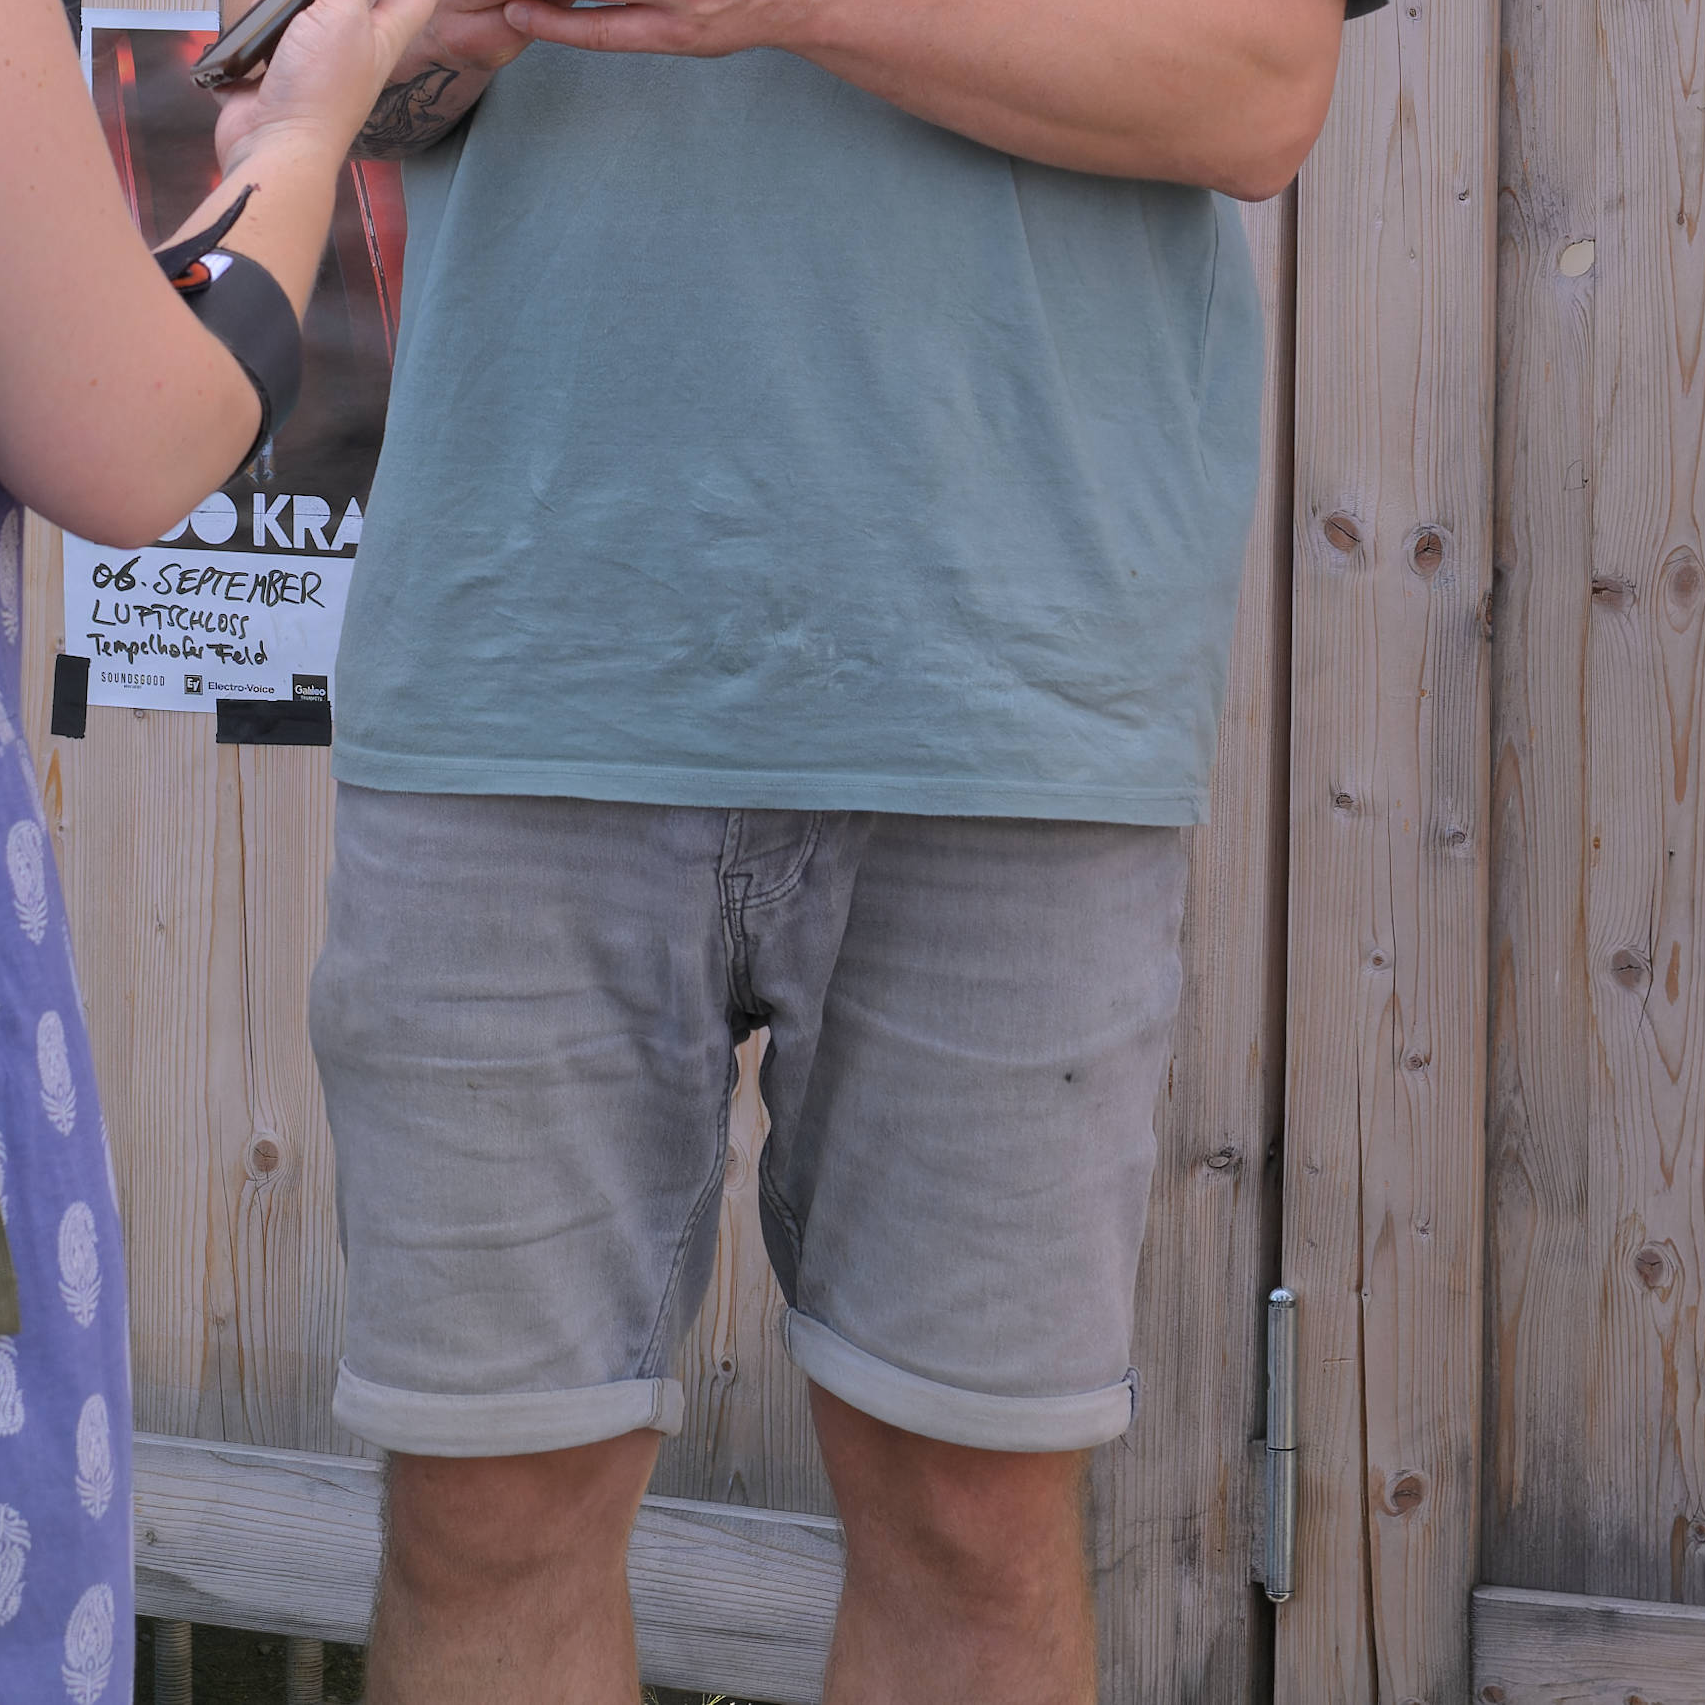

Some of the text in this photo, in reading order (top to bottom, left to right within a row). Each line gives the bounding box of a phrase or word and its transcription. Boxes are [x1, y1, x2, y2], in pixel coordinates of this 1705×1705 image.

[153, 563, 325, 608] SEPTEMBER
[101, 671, 165, 686] SOUNDSGOOD
[208, 681, 275, 694] Electro-Voice
